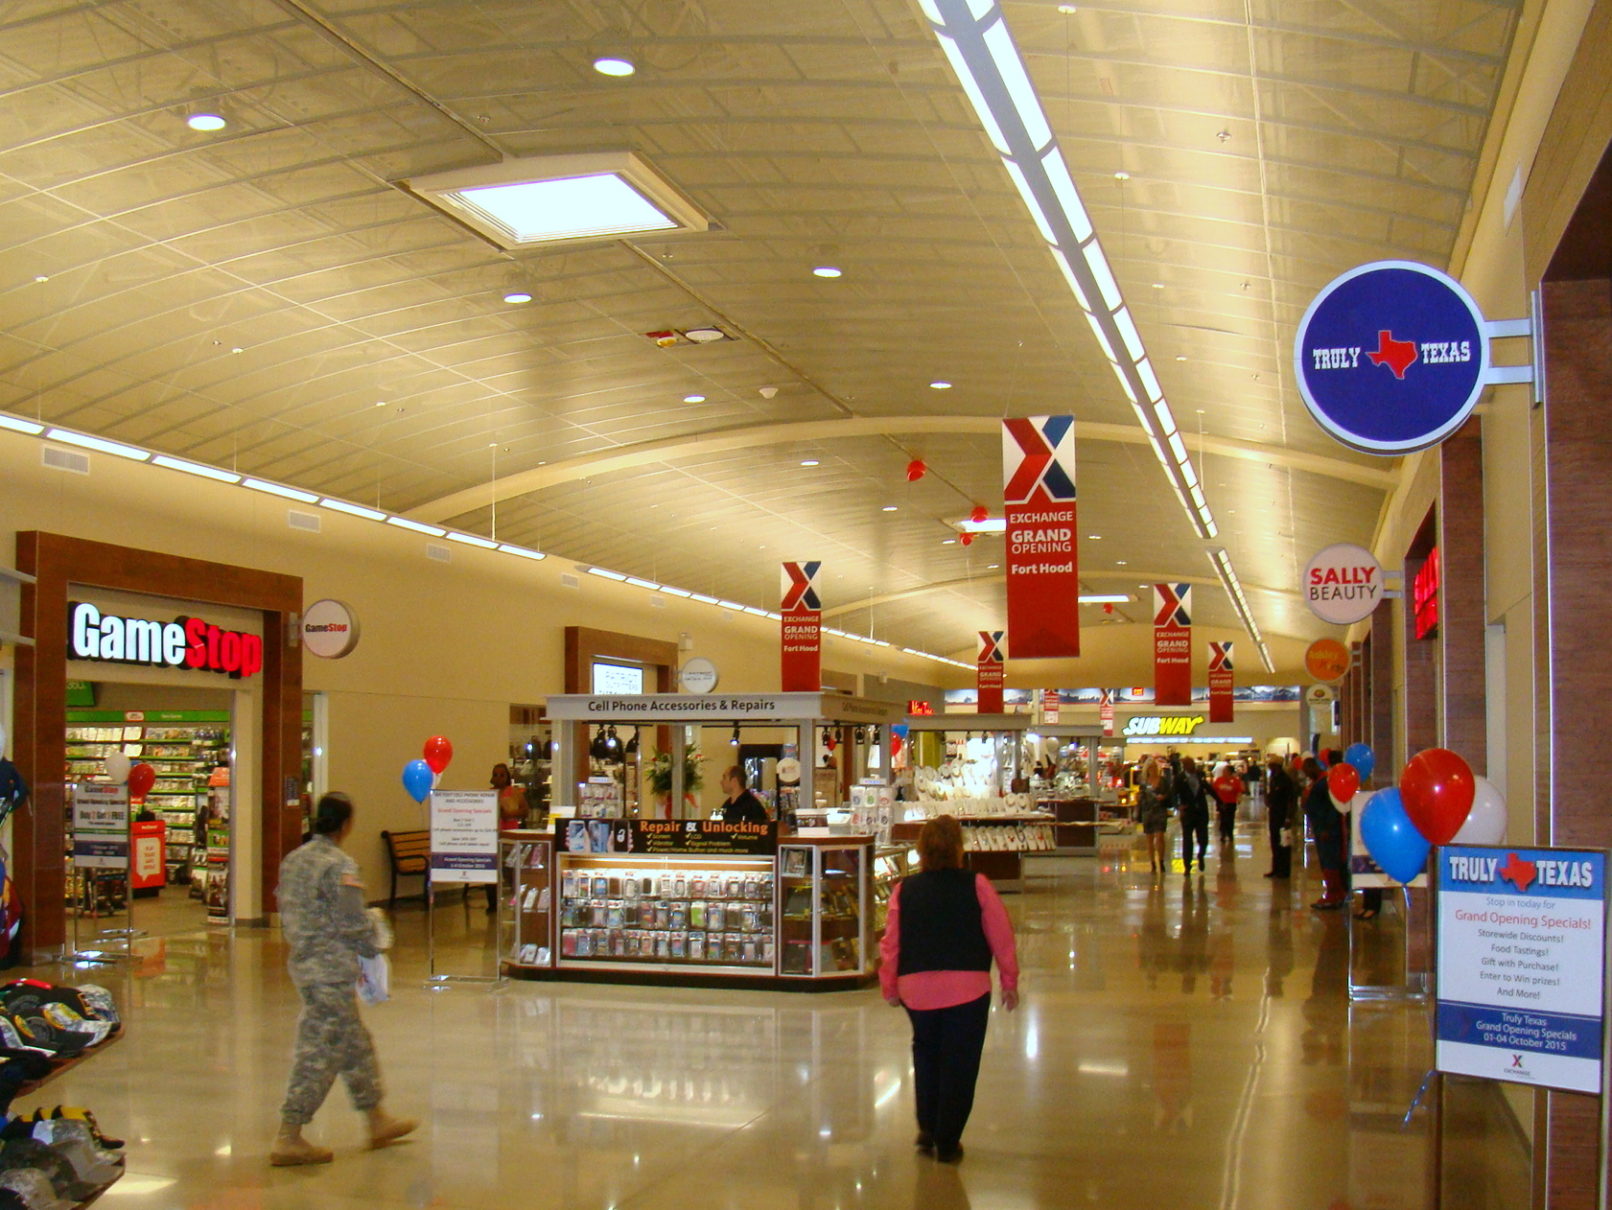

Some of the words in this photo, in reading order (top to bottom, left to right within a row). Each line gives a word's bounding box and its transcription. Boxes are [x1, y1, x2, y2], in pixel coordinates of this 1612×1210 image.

[1312, 347, 1361, 370] TRULY
[1421, 341, 1471, 364] TEXAS
[1009, 511, 1073, 524] EXCHANGE
[1011, 529, 1072, 543] GRAND
[1011, 541, 1072, 555] OPENING
[1011, 563, 1038, 575] Fort
[1039, 562, 1073, 574] Hood
[1310, 566, 1376, 585] SALLY
[1310, 585, 1377, 601] BEAUTY
[305, 623, 348, 632] GameStop
[73, 602, 262, 677] GameStop
[1157, 640, 1188, 648] GRAND
[588, 702, 609, 712] Cell
[612, 701, 648, 712] Phone
[650, 700, 717, 711] Accessories
[719, 700, 728, 710] &
[731, 699, 775, 713] Repairs
[1122, 715, 1204, 736] SUBWAY
[640, 820, 682, 834] Repair
[685, 822, 698, 832] &
[702, 820, 769, 836] Unlocking
[1450, 856, 1498, 882] TRULY
[1536, 860, 1593, 888] TEXAS
[1486, 897, 1506, 908] Stop
[1517, 899, 1542, 910] today
[1543, 900, 1556, 909] for
[1455, 909, 1488, 922] Grand
[1489, 911, 1539, 928] Opening
[1541, 914, 1592, 930] Specials!
[1478, 928, 1518, 940] Storewide
[1520, 931, 1564, 943] Discounts!
[1491, 944, 1511, 954] Food
[1513, 945, 1550, 958] Tastings!
[1481, 957, 1496, 967] Gift
[1498, 958, 1516, 968] with
[1518, 960, 1559, 973] Purchase!
[1480, 971, 1502, 981] Enter
[1503, 973, 1512, 982] to
[1513, 974, 1531, 984] Win
[1532, 976, 1560, 987] prizes!
[1497, 987, 1514, 997] And
[1515, 989, 1541, 1000] More!
[1502, 1012, 1523, 1025] Truly
[1524, 1014, 1548, 1026] Texas
[1476, 1020, 1502, 1032] Grand
[1502, 1023, 1540, 1039] Opening
[1541, 1027, 1578, 1041] Specials
[1483, 1033, 1508, 1044] 01-04
[1508, 1035, 1544, 1048] October
[1545, 1040, 1567, 1051] 2015
